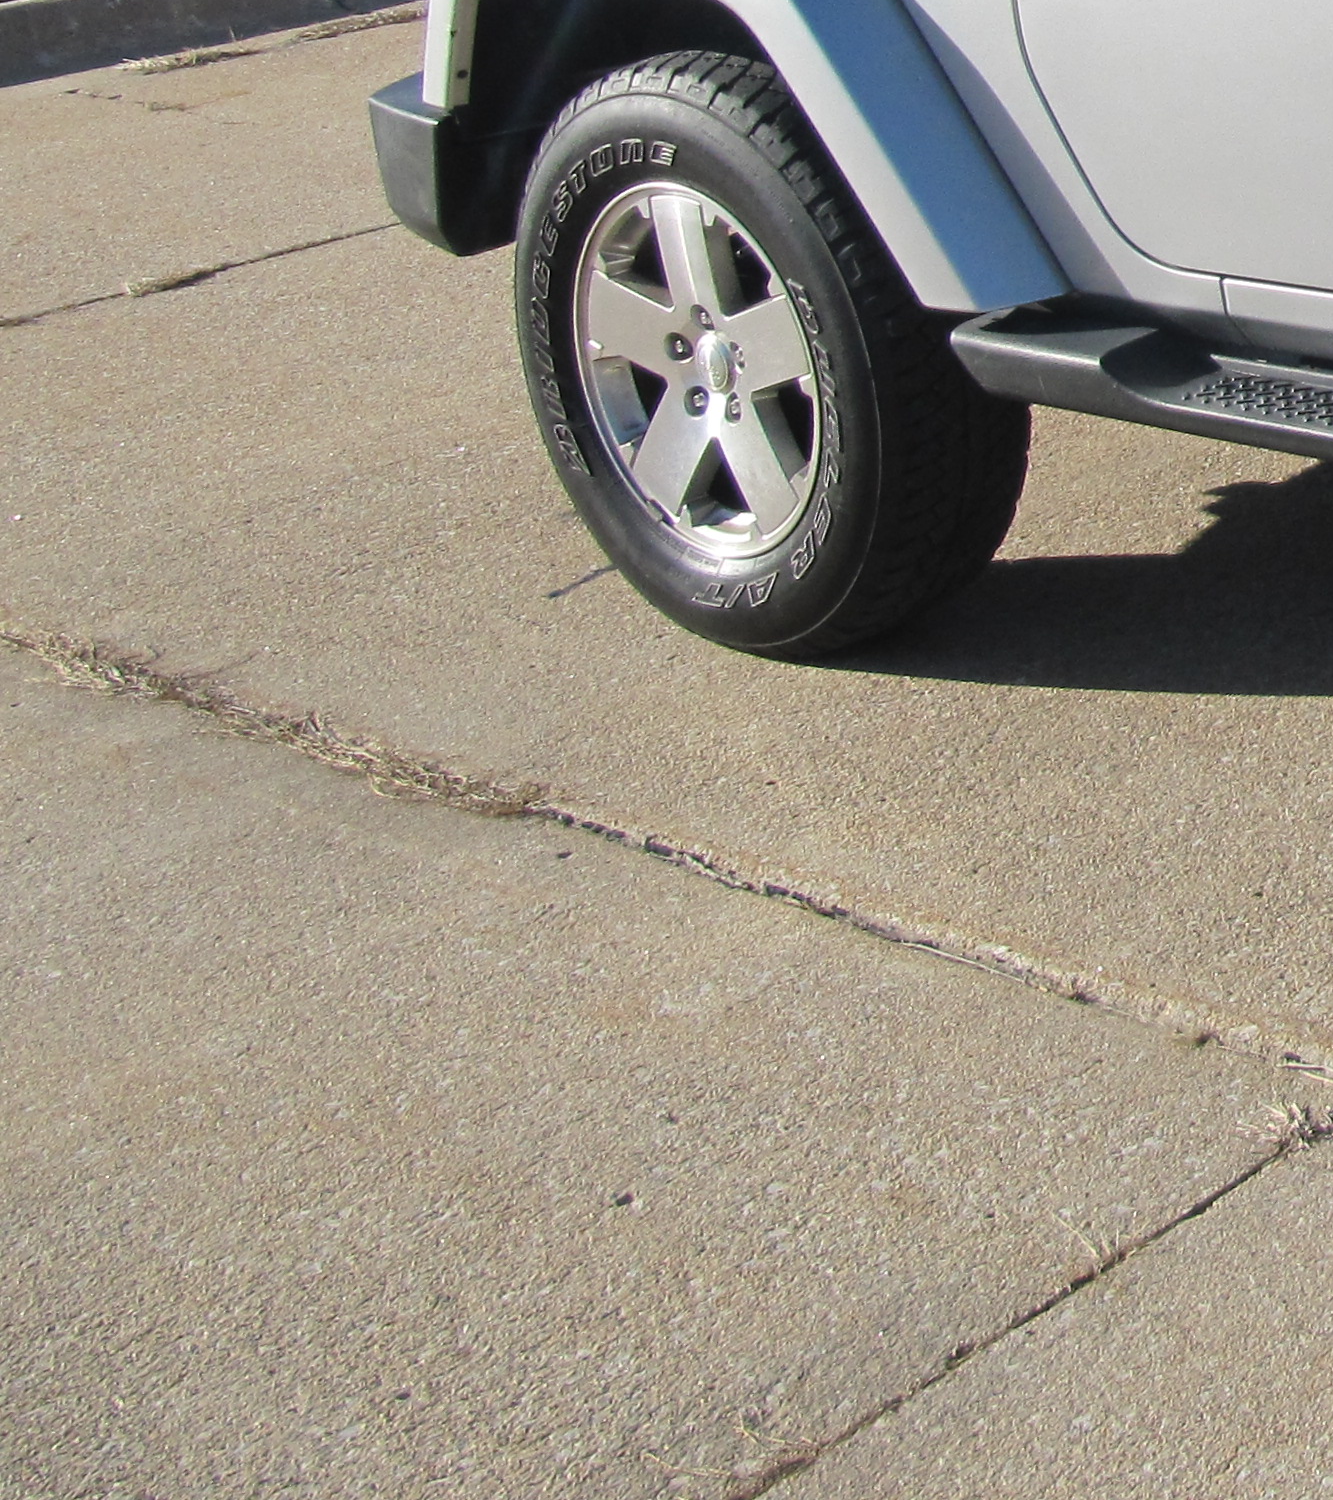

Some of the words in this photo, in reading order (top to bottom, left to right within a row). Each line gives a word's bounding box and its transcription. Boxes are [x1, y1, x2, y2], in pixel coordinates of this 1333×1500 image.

[532, 137, 678, 476] BRIDGESTONE
[787, 277, 845, 581] DUELER
[693, 571, 780, 609] A/T
